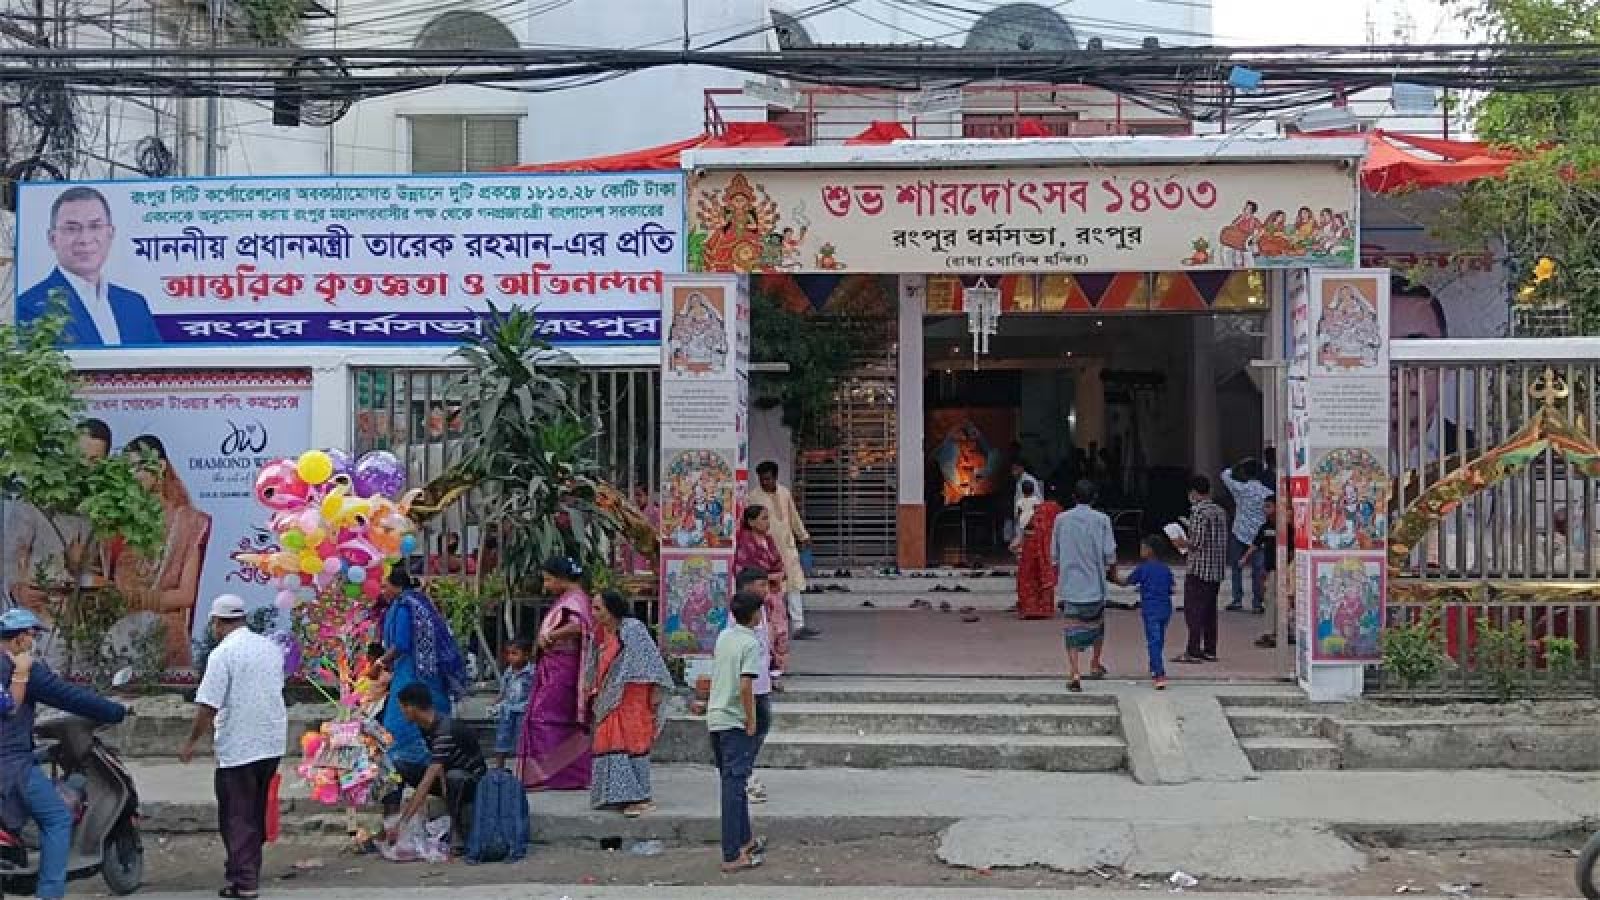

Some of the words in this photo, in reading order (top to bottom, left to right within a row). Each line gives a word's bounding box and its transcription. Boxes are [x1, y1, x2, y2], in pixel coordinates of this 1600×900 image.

[602, 179, 640, 199] কোটি
[644, 180, 676, 198] টাকা
[822, 184, 885, 217] শুভ
[896, 178, 1089, 217] শারদোৎসব
[1101, 180, 1217, 213] ১৪৩৩
[131, 225, 228, 262] মাননীয়
[236, 223, 355, 260] প্রধানমন্ত্রী
[361, 232, 454, 259] তারেক
[464, 231, 608, 259] রহমান-এর
[616, 222, 676, 257] প্রতি
[893, 228, 957, 253] রংপুর
[1076, 226, 1142, 250] রংপুর
[160, 263, 305, 302] আন্তরিক
[314, 272, 448, 306] কৃতজ্ঞতা
[461, 273, 485, 297] ও
[494, 262, 664, 297] অভিনন্দন
[176, 318, 310, 340] রংপুর
[535, 316, 660, 338] রংপুর
[189, 457, 251, 471] DIAMOND
